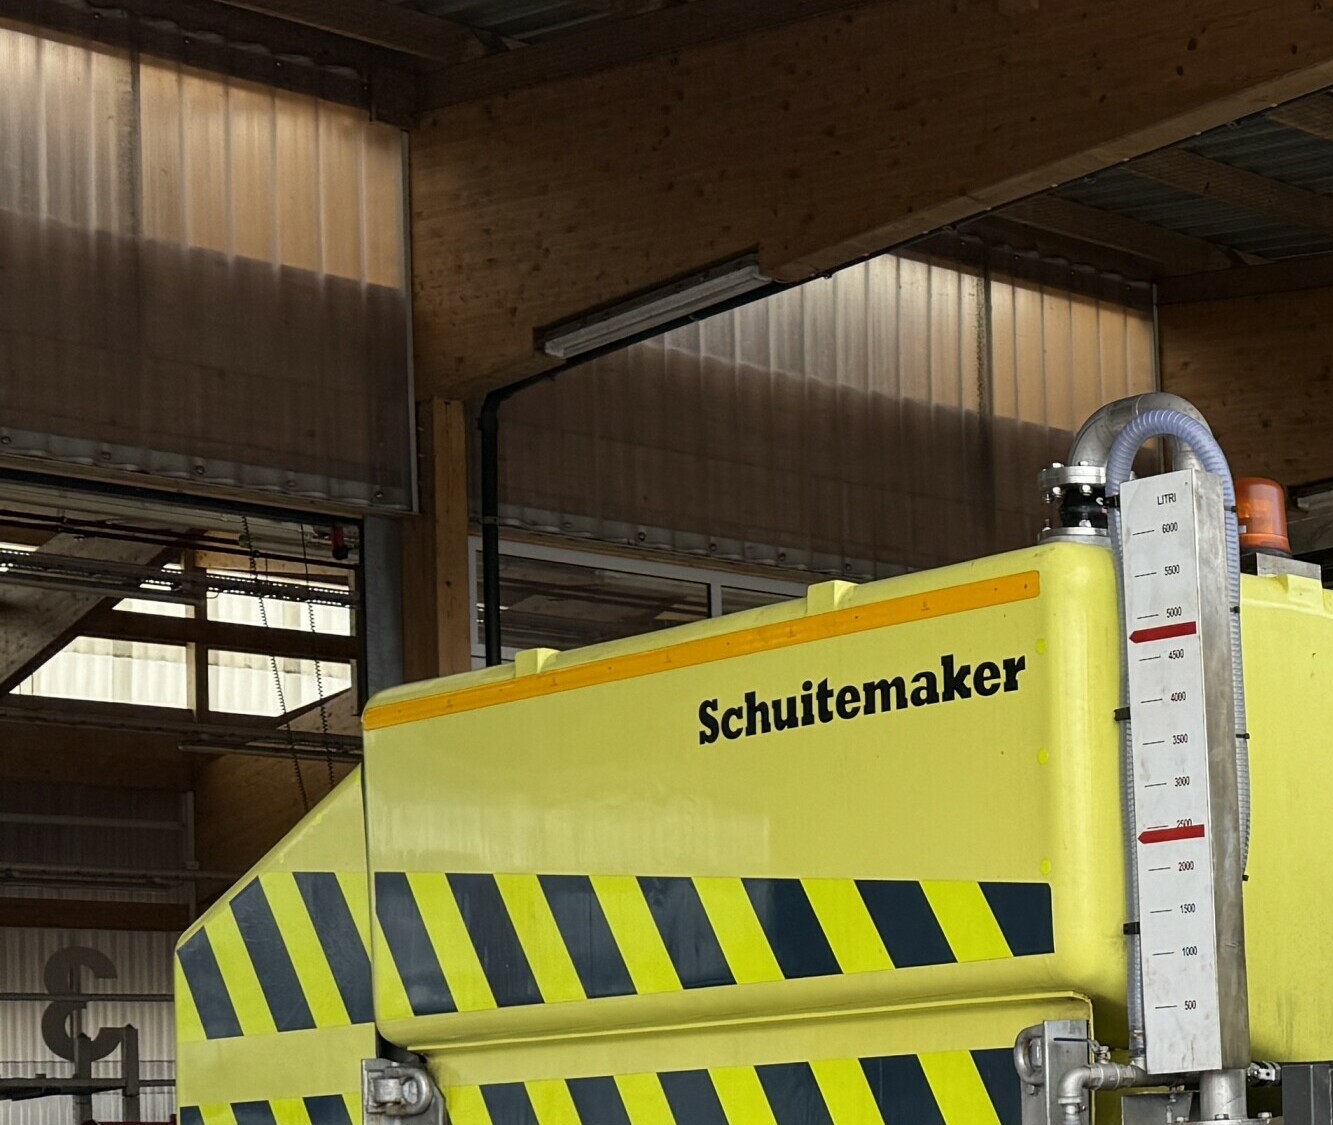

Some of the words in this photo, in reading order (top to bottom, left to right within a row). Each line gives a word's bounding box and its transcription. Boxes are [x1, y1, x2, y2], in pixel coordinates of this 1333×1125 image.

[1157, 493, 1177, 506] LITRI
[1162, 522, 1178, 533] 6000
[1164, 564, 1180, 576] 5500
[1166, 606, 1182, 618] 5000
[1168, 649, 1184, 660] 4500
[698, 653, 1026, 745] Schuitemaker
[1170, 691, 1186, 702] 4000
[1172, 733, 1188, 745] 3500
[1174, 776, 1190, 787] 3000
[1178, 860, 1194, 872] 2000
[1180, 903, 1196, 914] 1500
[1181, 945, 1197, 956] 1000
[1184, 1000, 1197, 1011] 500
